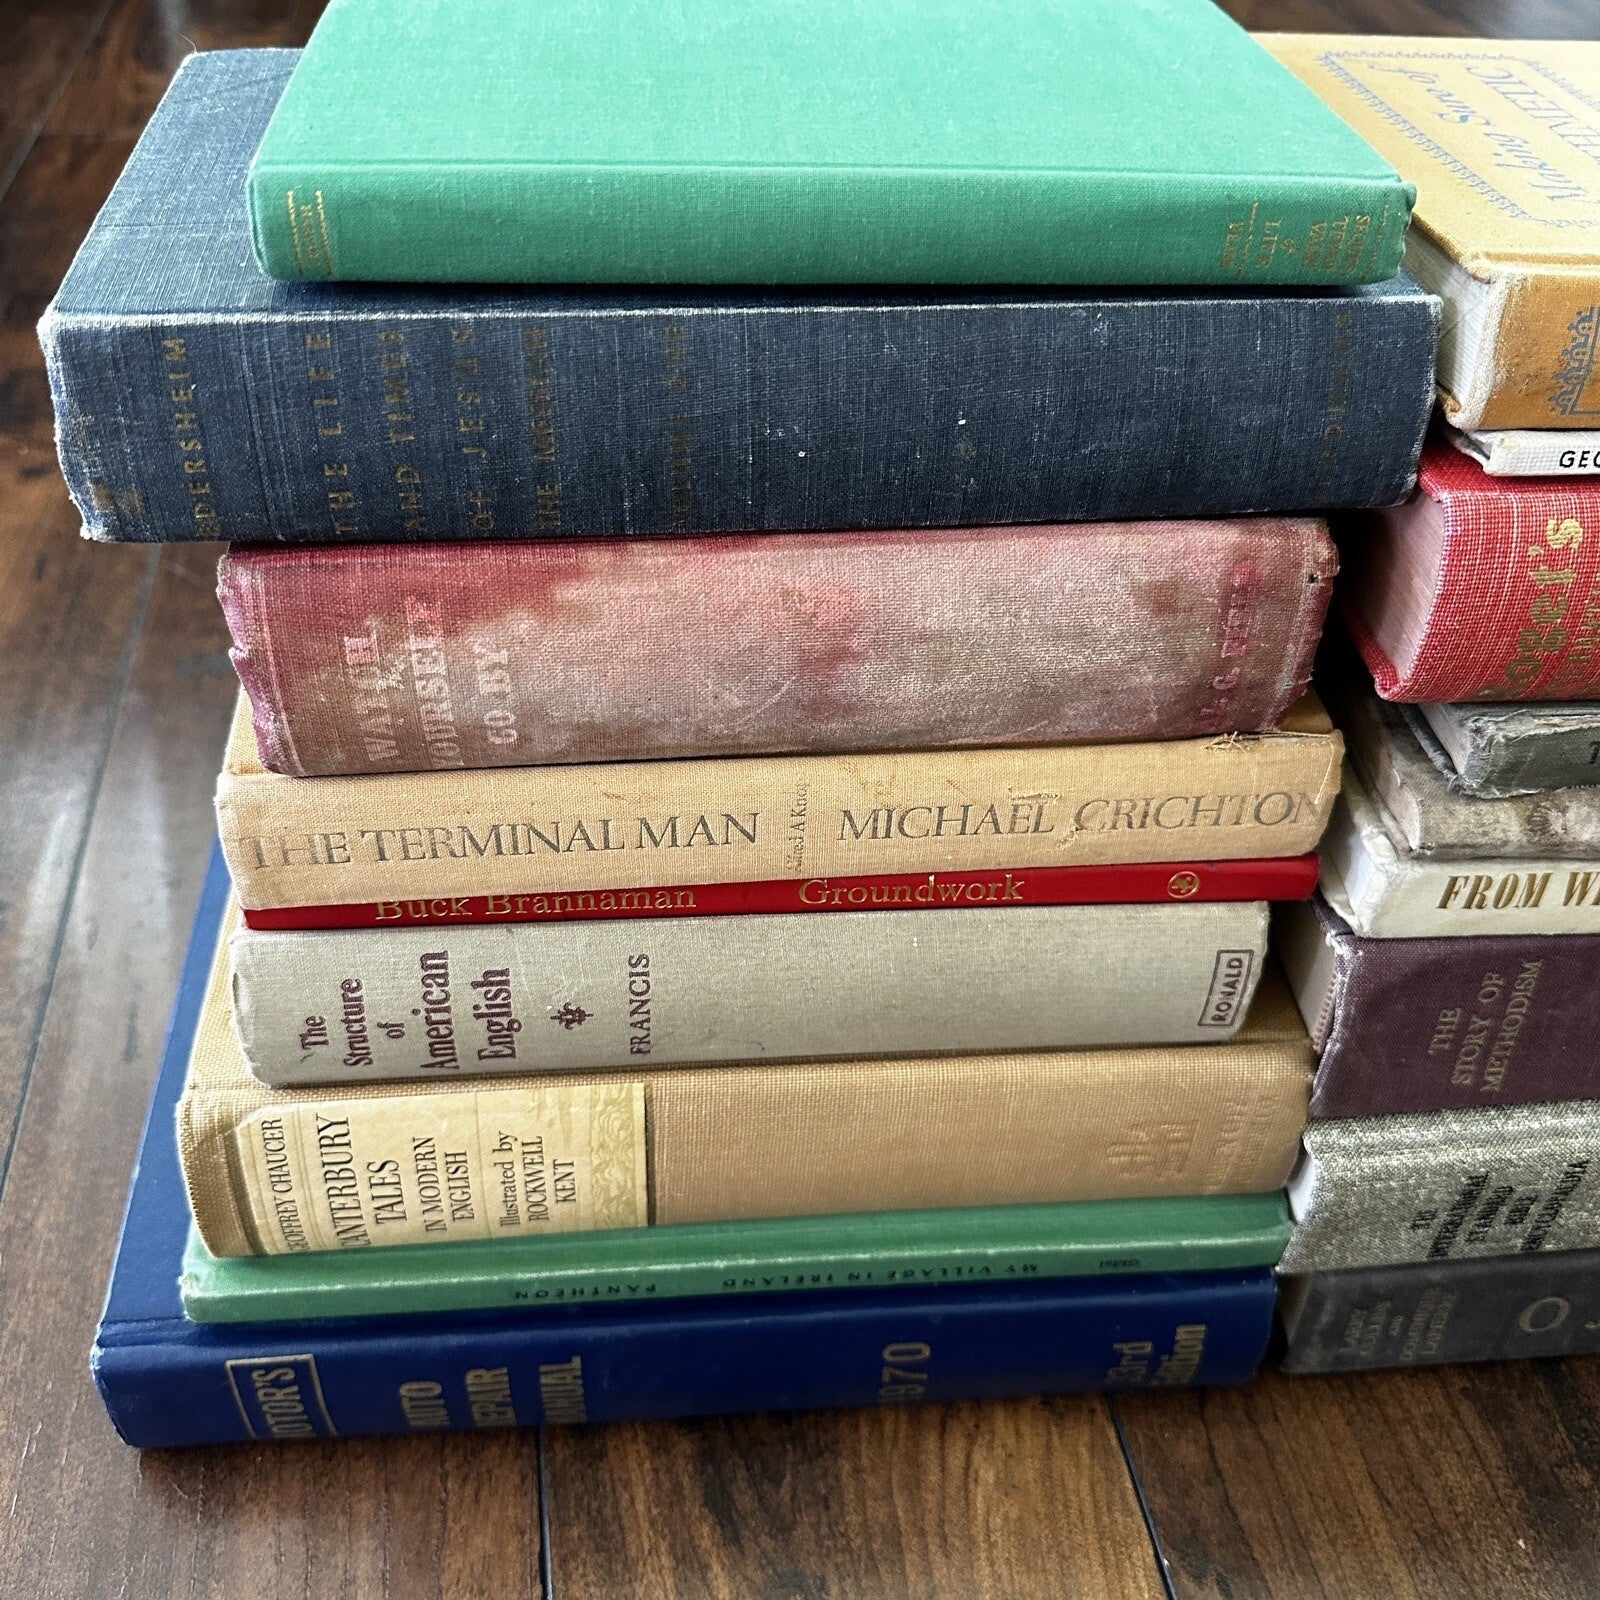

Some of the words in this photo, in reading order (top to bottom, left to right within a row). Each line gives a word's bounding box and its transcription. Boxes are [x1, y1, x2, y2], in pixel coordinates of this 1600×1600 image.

[1367, 63, 1438, 84] of
[1434, 87, 1492, 126] Sure
[1483, 132, 1599, 203] Making
[307, 332, 341, 436] LIFE
[379, 331, 415, 445] TIMES
[452, 327, 487, 456] JESUS
[324, 463, 358, 535] THE
[396, 469, 424, 532] AND
[468, 489, 494, 531] OF
[536, 483, 560, 529] THE
[343, 632, 400, 763] WATCH
[484, 709, 518, 745] GO
[238, 831, 352, 870] THE
[360, 818, 626, 863] TERMINAL
[635, 812, 760, 849] MAN
[836, 801, 1056, 841] MICHAEL
[1073, 791, 1324, 831] CRICHTON
[485, 887, 697, 915] Brannaman
[798, 874, 1025, 906] Groundwork
[1436, 873, 1553, 910] FROM
[411, 950, 461, 1071] American
[470, 967, 523, 1061] English
[628, 953, 652, 1056] FRANCIS
[1210, 957, 1243, 1022] RONALD
[299, 1015, 331, 1052] The
[341, 977, 375, 1068] Structure
[376, 1019, 406, 1041] of
[1428, 1007, 1463, 1056] THE
[1450, 1013, 1494, 1086] STORY
[1479, 971, 1505, 1005] OF
[1480, 957, 1545, 1094] METHODISM
[260, 1116, 294, 1193] CHAUCER
[492, 1130, 518, 1154] by
[366, 1159, 408, 1225] TALES
[412, 1136, 445, 1214] MODERN
[445, 1150, 475, 1222] ENGLISH
[493, 1160, 521, 1228] Illustrated
[521, 1135, 550, 1222] ROCKWELL
[552, 1158, 578, 1205] KENT
[422, 1215, 448, 1233] IN
[515, 1283, 657, 1300] PANTHEON
[722, 1272, 834, 1289] IRELAND
[848, 1271, 873, 1282] IN
[886, 1264, 993, 1281] VILLAGE
